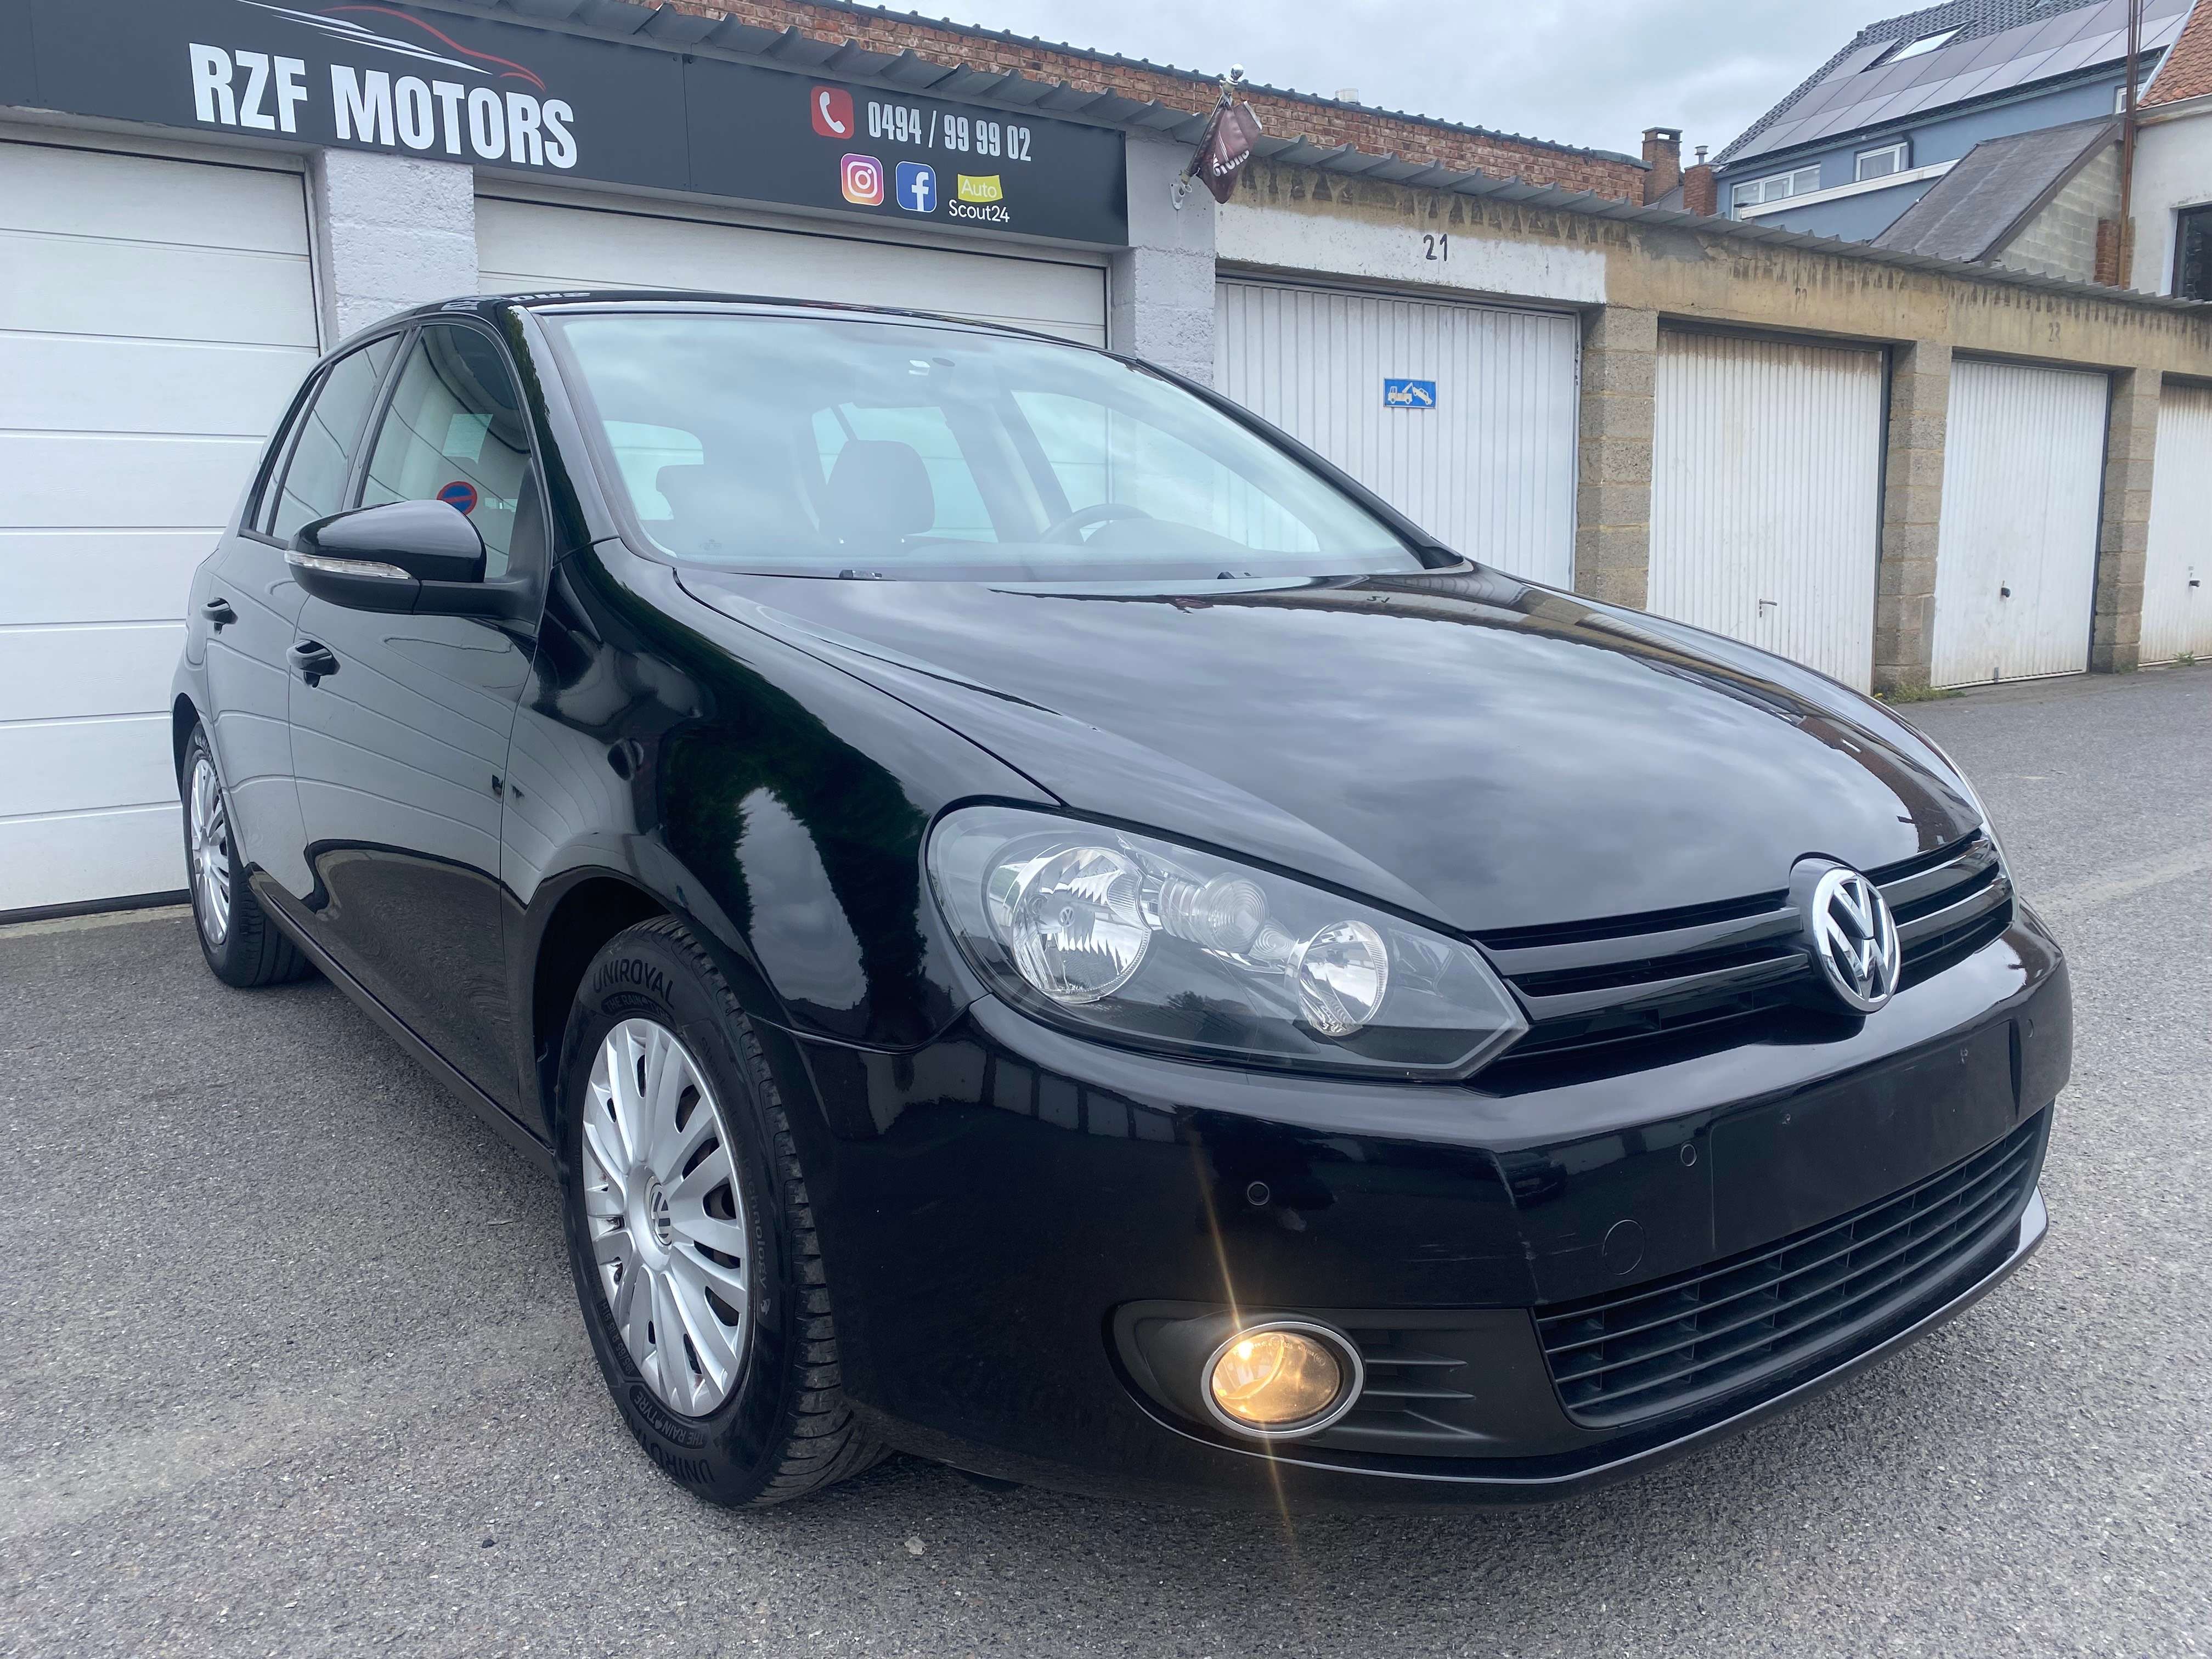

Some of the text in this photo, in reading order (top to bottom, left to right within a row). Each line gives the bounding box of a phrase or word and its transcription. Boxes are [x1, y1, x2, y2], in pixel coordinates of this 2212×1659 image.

[189, 43, 578, 169] RZF MOTORS
[868, 101, 1031, 161] 0494 / 99 99 02
[961, 178, 997, 199] Auto
[949, 199, 1010, 223] Scout24
[1423, 234, 1448, 262] 21
[593, 958, 675, 1010] UNIROYAL
[606, 996, 622, 1011] THE
[634, 1391, 704, 1446] THE RAIN TYRE
